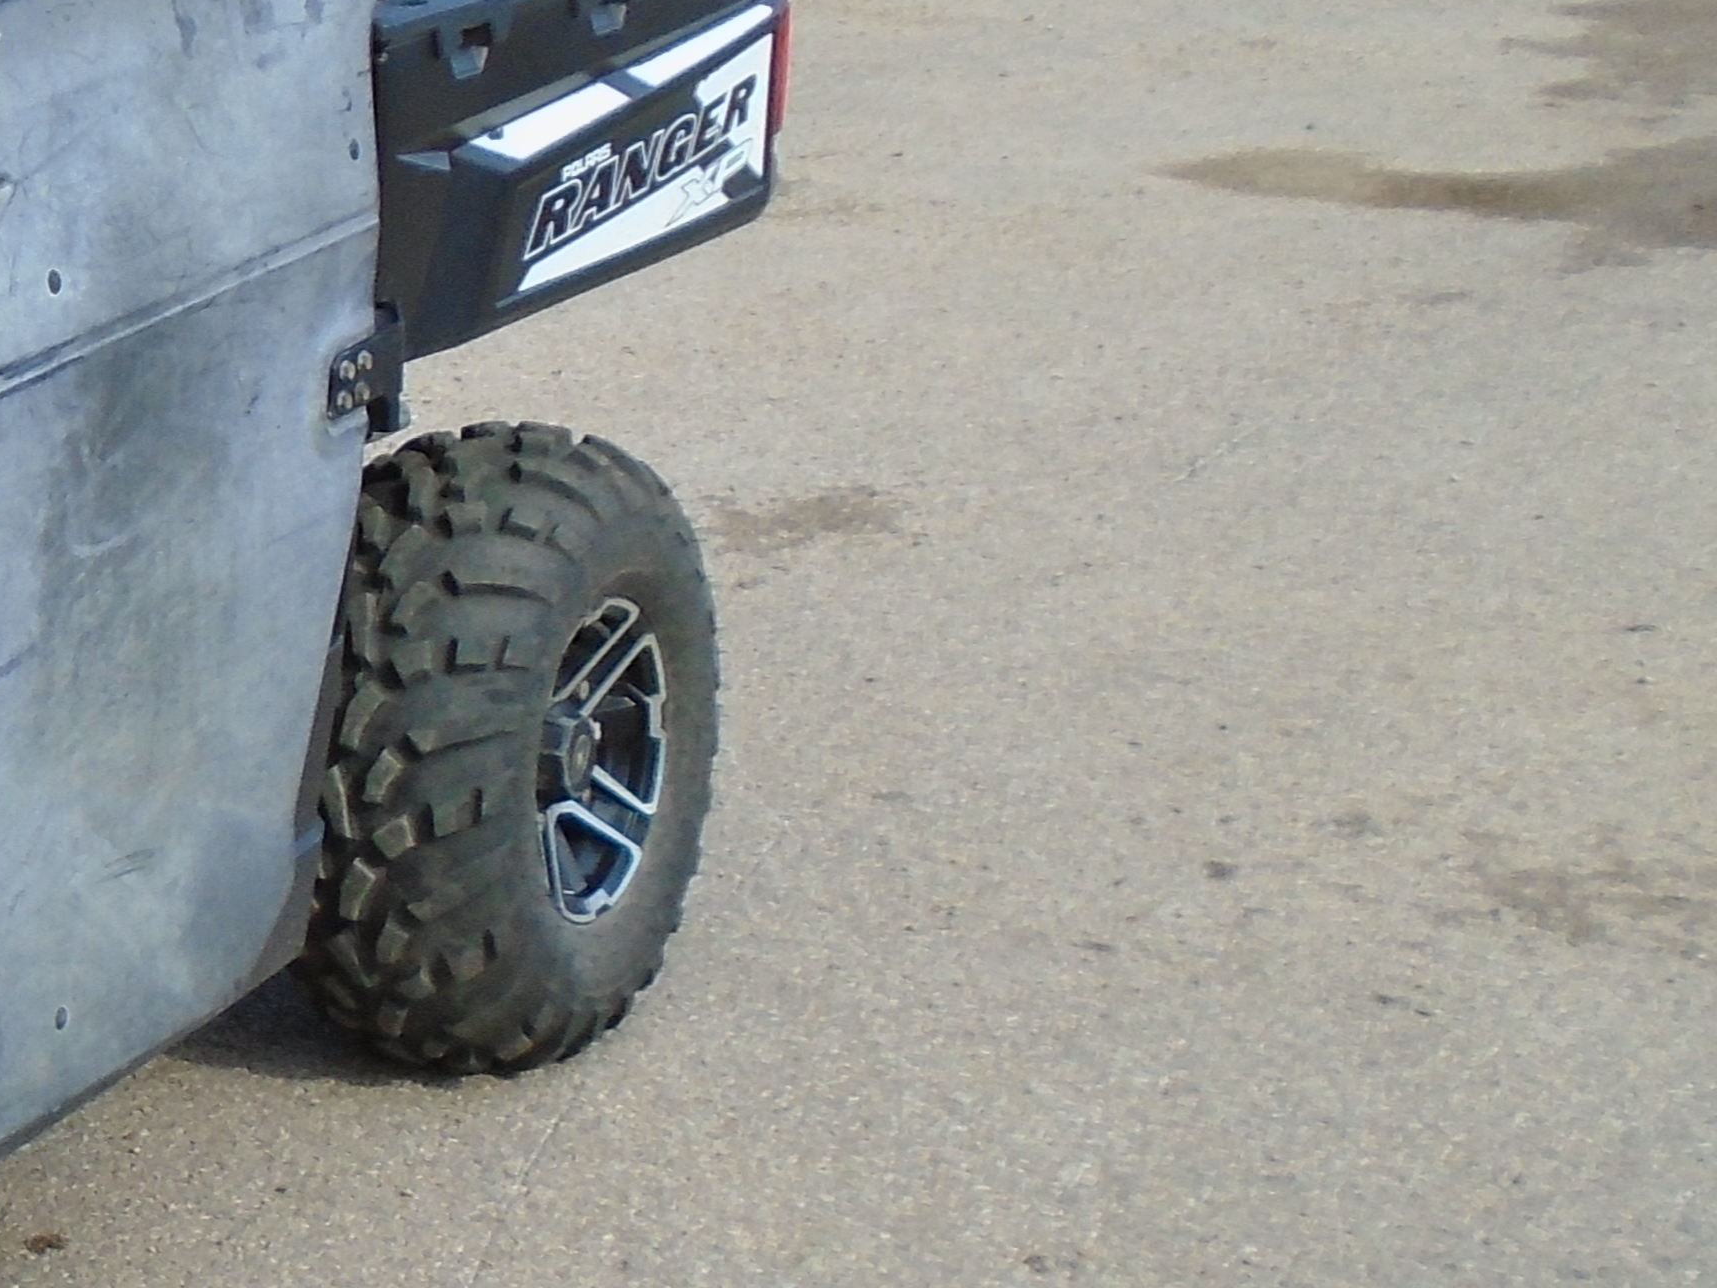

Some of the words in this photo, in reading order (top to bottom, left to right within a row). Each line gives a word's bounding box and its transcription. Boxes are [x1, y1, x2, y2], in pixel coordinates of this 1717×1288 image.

[522, 73, 757, 261] RANGER
[560, 142, 612, 182] POLARIS
[664, 136, 753, 228] XP
